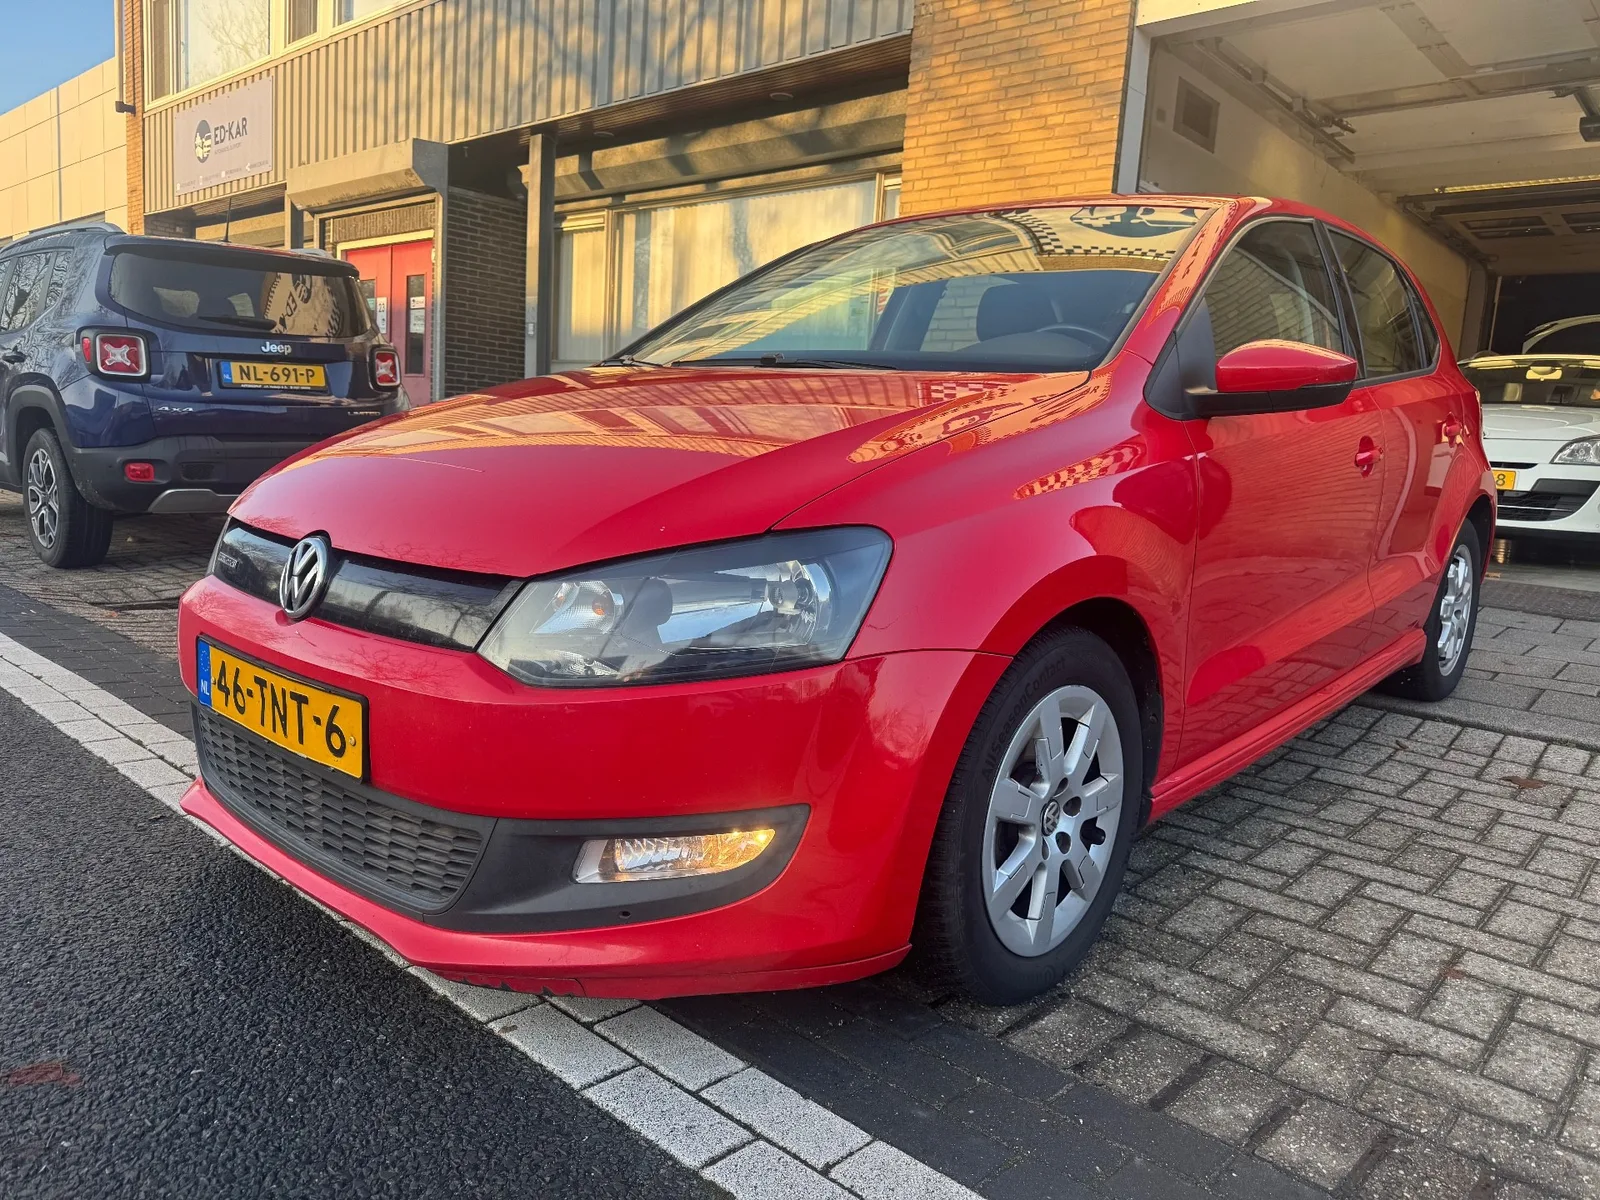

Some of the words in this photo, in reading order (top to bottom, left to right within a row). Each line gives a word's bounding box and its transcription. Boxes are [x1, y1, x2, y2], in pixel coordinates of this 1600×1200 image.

[214, 117, 248, 145] ED-KAR
[261, 341, 292, 355] Jeep
[239, 364, 315, 383] NL-691-P
[200, 678, 210, 696] NL
[217, 660, 346, 758] 46-TNT-6
